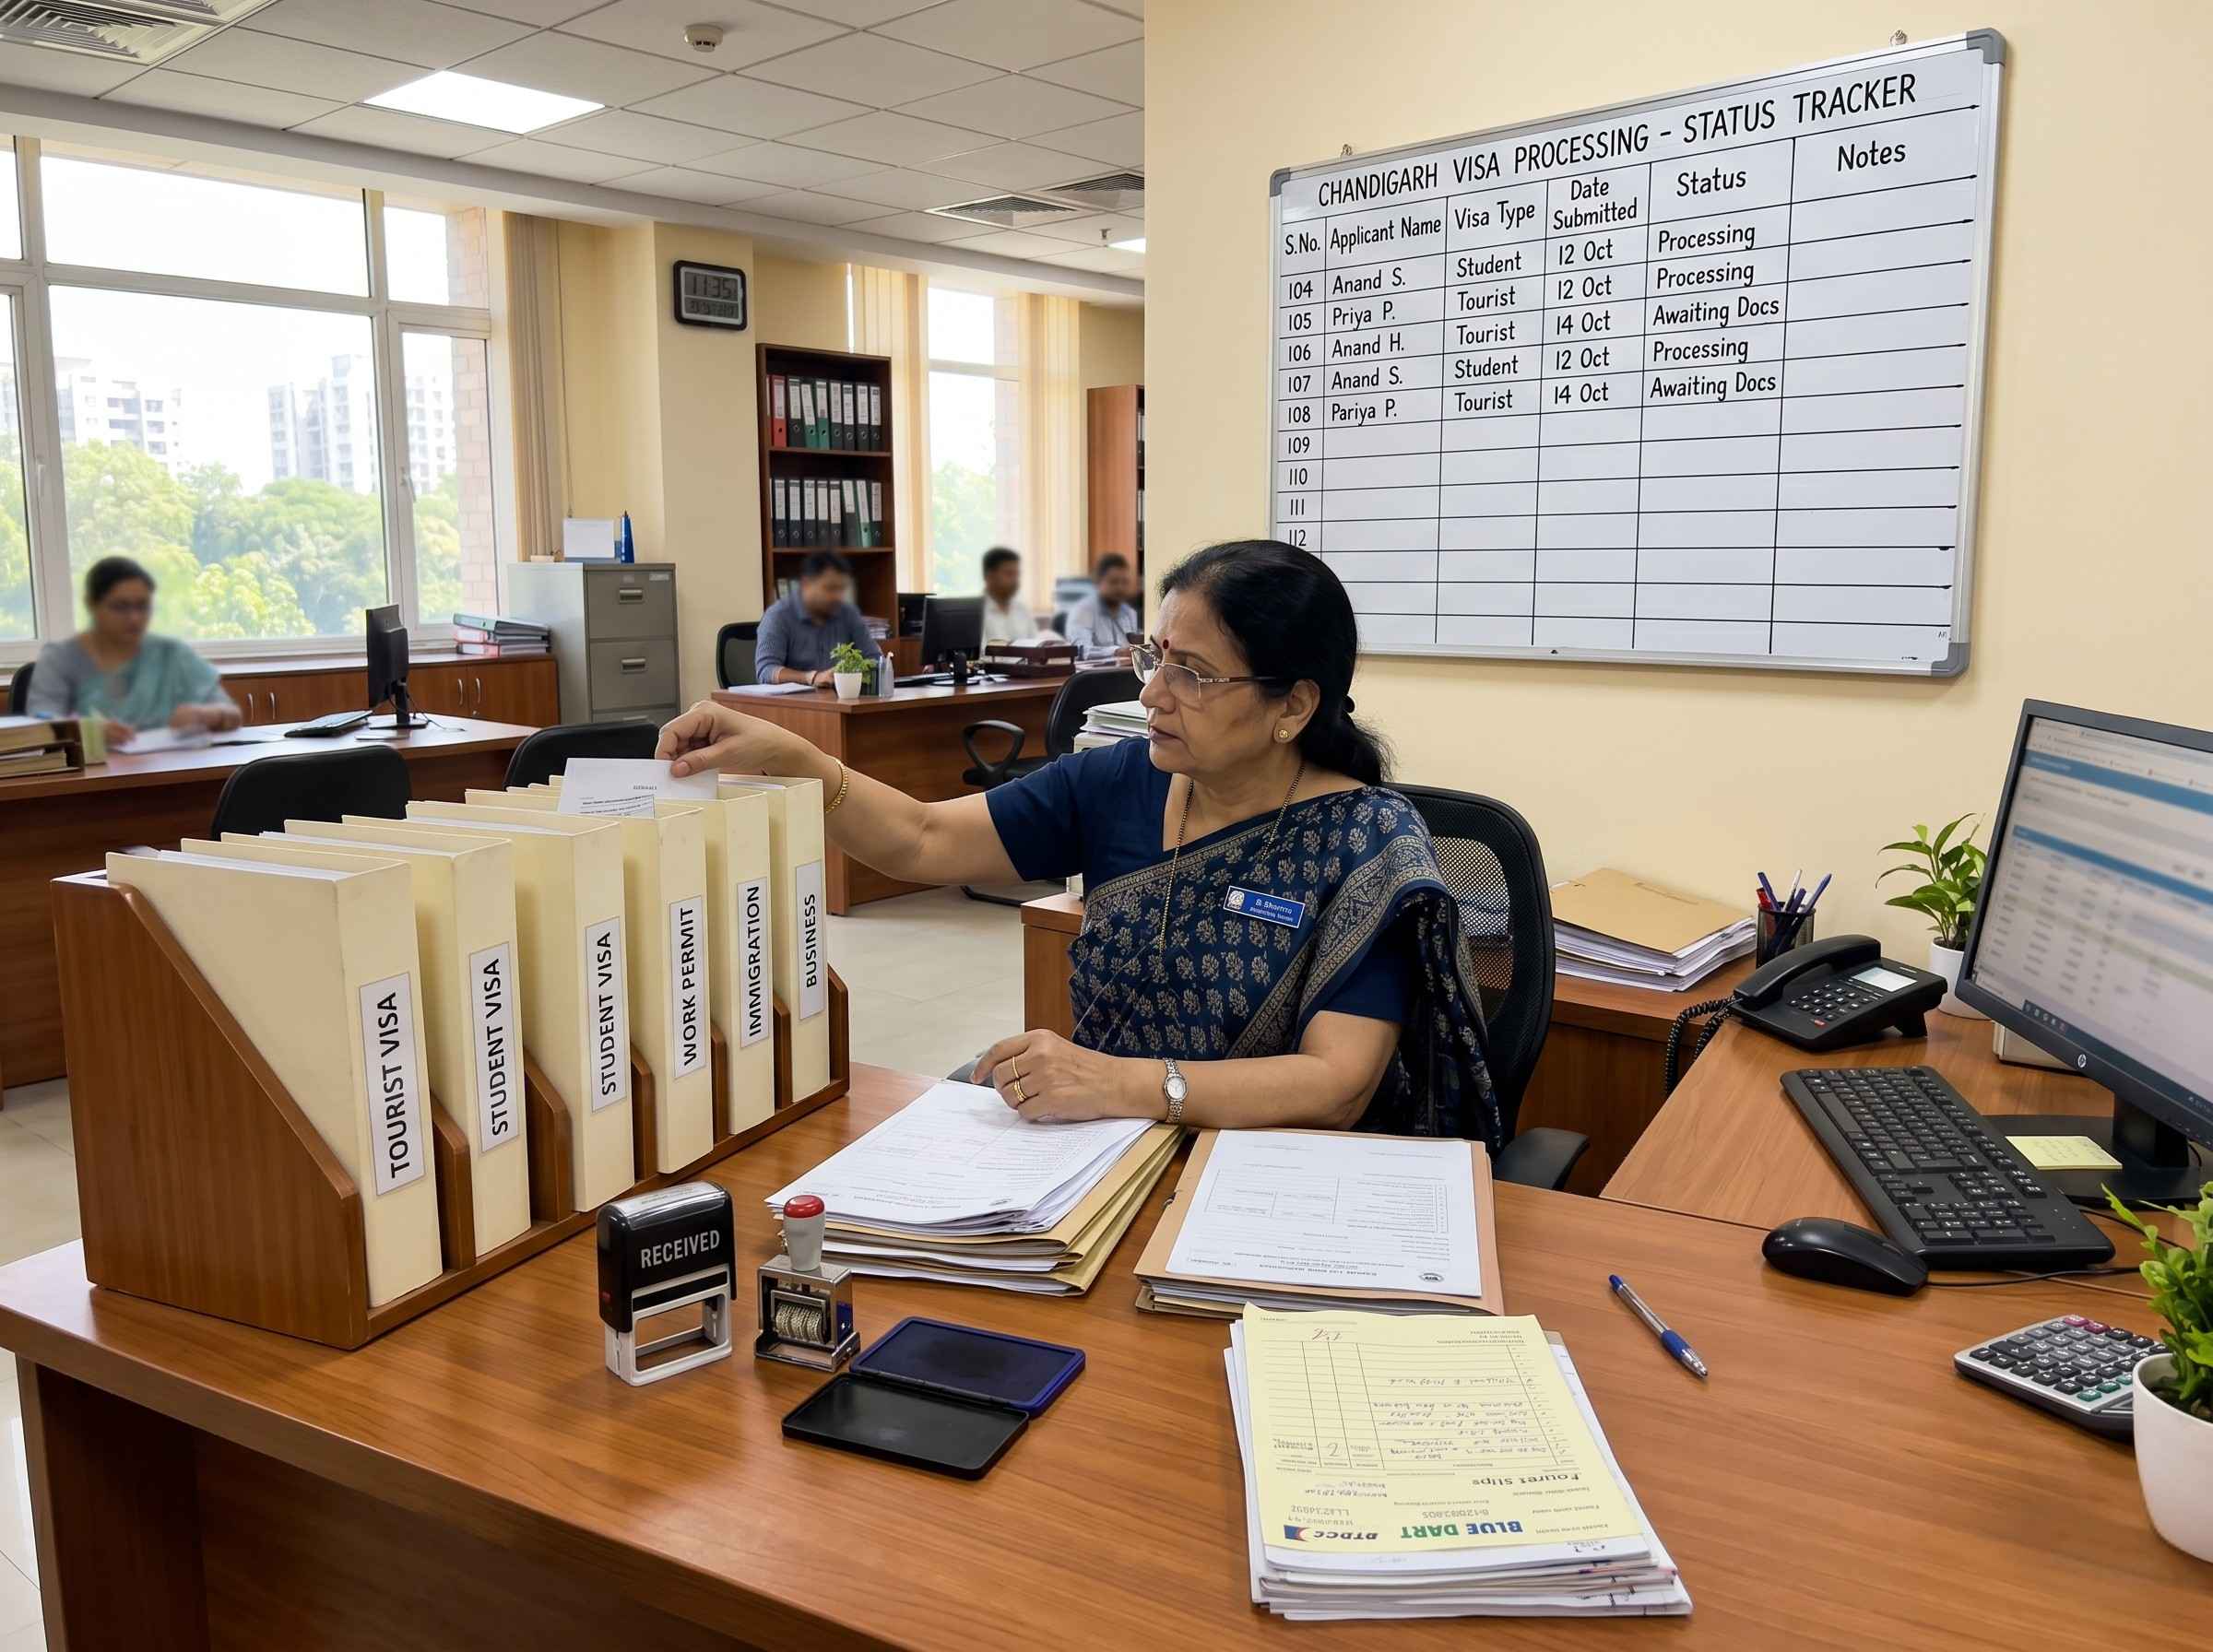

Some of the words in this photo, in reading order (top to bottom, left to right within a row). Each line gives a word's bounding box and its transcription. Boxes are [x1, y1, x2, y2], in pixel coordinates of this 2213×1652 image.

[1318, 161, 1438, 207] CHANDIGARH
[1452, 151, 1501, 185] VISA
[1514, 124, 1650, 174] PROCESSING
[1682, 99, 1776, 144] STATUS
[1792, 73, 1916, 124] TRACKER
[1837, 139, 1907, 172] Notes
[1570, 176, 1610, 201] Date
[1675, 166, 1747, 197] Status
[1329, 218, 1395, 255] Applicant
[1401, 215, 1442, 240] Name
[1453, 206, 1490, 230] Visa
[1496, 199, 1535, 231] Type
[1552, 195, 1638, 231] Submitted
[1284, 230, 1321, 256] S.No.
[1288, 279, 1314, 301] 104
[1331, 268, 1382, 296] Anand
[1391, 266, 1406, 288] S.
[1456, 250, 1522, 278] Student
[1558, 242, 1575, 266] 12
[1583, 237, 1614, 263] Oct
[1658, 224, 1756, 254] Processing
[1288, 311, 1312, 332] 105
[1331, 306, 1372, 330] Priya
[1382, 300, 1396, 322] P.
[1456, 284, 1517, 312] Tourist
[1557, 278, 1574, 301] 12
[1581, 273, 1613, 298] Oct
[1657, 260, 1755, 290] Processing
[1288, 343, 1312, 365] 106
[1331, 333, 1381, 360] Anand
[1390, 331, 1405, 353] H.
[1455, 320, 1516, 346] Tourist
[1556, 313, 1575, 336] 14
[1580, 309, 1612, 334] Oct
[1652, 301, 1729, 330] Awaiting
[1737, 295, 1780, 318] Docs
[1288, 374, 1312, 394] 107
[1331, 366, 1380, 391] Anand
[1388, 365, 1403, 385] S.
[1453, 354, 1520, 380] Student
[1556, 348, 1572, 372] 12
[1580, 346, 1611, 370] Oct
[1652, 336, 1749, 367] Processing
[1288, 405, 1311, 425] 108
[1331, 401, 1377, 427] Pariya
[1385, 397, 1398, 419] P.
[1453, 388, 1513, 413] Tourist
[1554, 384, 1572, 406] 14
[1580, 381, 1609, 404] Oct
[1651, 373, 1729, 403] Awaiting
[1734, 371, 1777, 394] Docs
[1287, 435, 1310, 455] 109
[1289, 466, 1308, 487] 110
[1290, 498, 1305, 516] 111
[1288, 528, 1308, 548] 112
[596, 931, 612, 990] VISA
[680, 907, 695, 994] PERMIT
[746, 886, 762, 1037] IMMIGRATION
[803, 893, 817, 988] BUSINESS
[481, 958, 502, 1020] VISA
[376, 991, 401, 1059] VISA
[599, 996, 618, 1094] STUDENT
[681, 995, 697, 1067] WORK
[482, 1025, 509, 1136] STUDENT
[385, 1063, 412, 1179] TOURIST
[641, 1230, 720, 1268] RECEIVED
[1401, 1521, 1459, 1540] DART
[1467, 1519, 1523, 1535] BLUE
